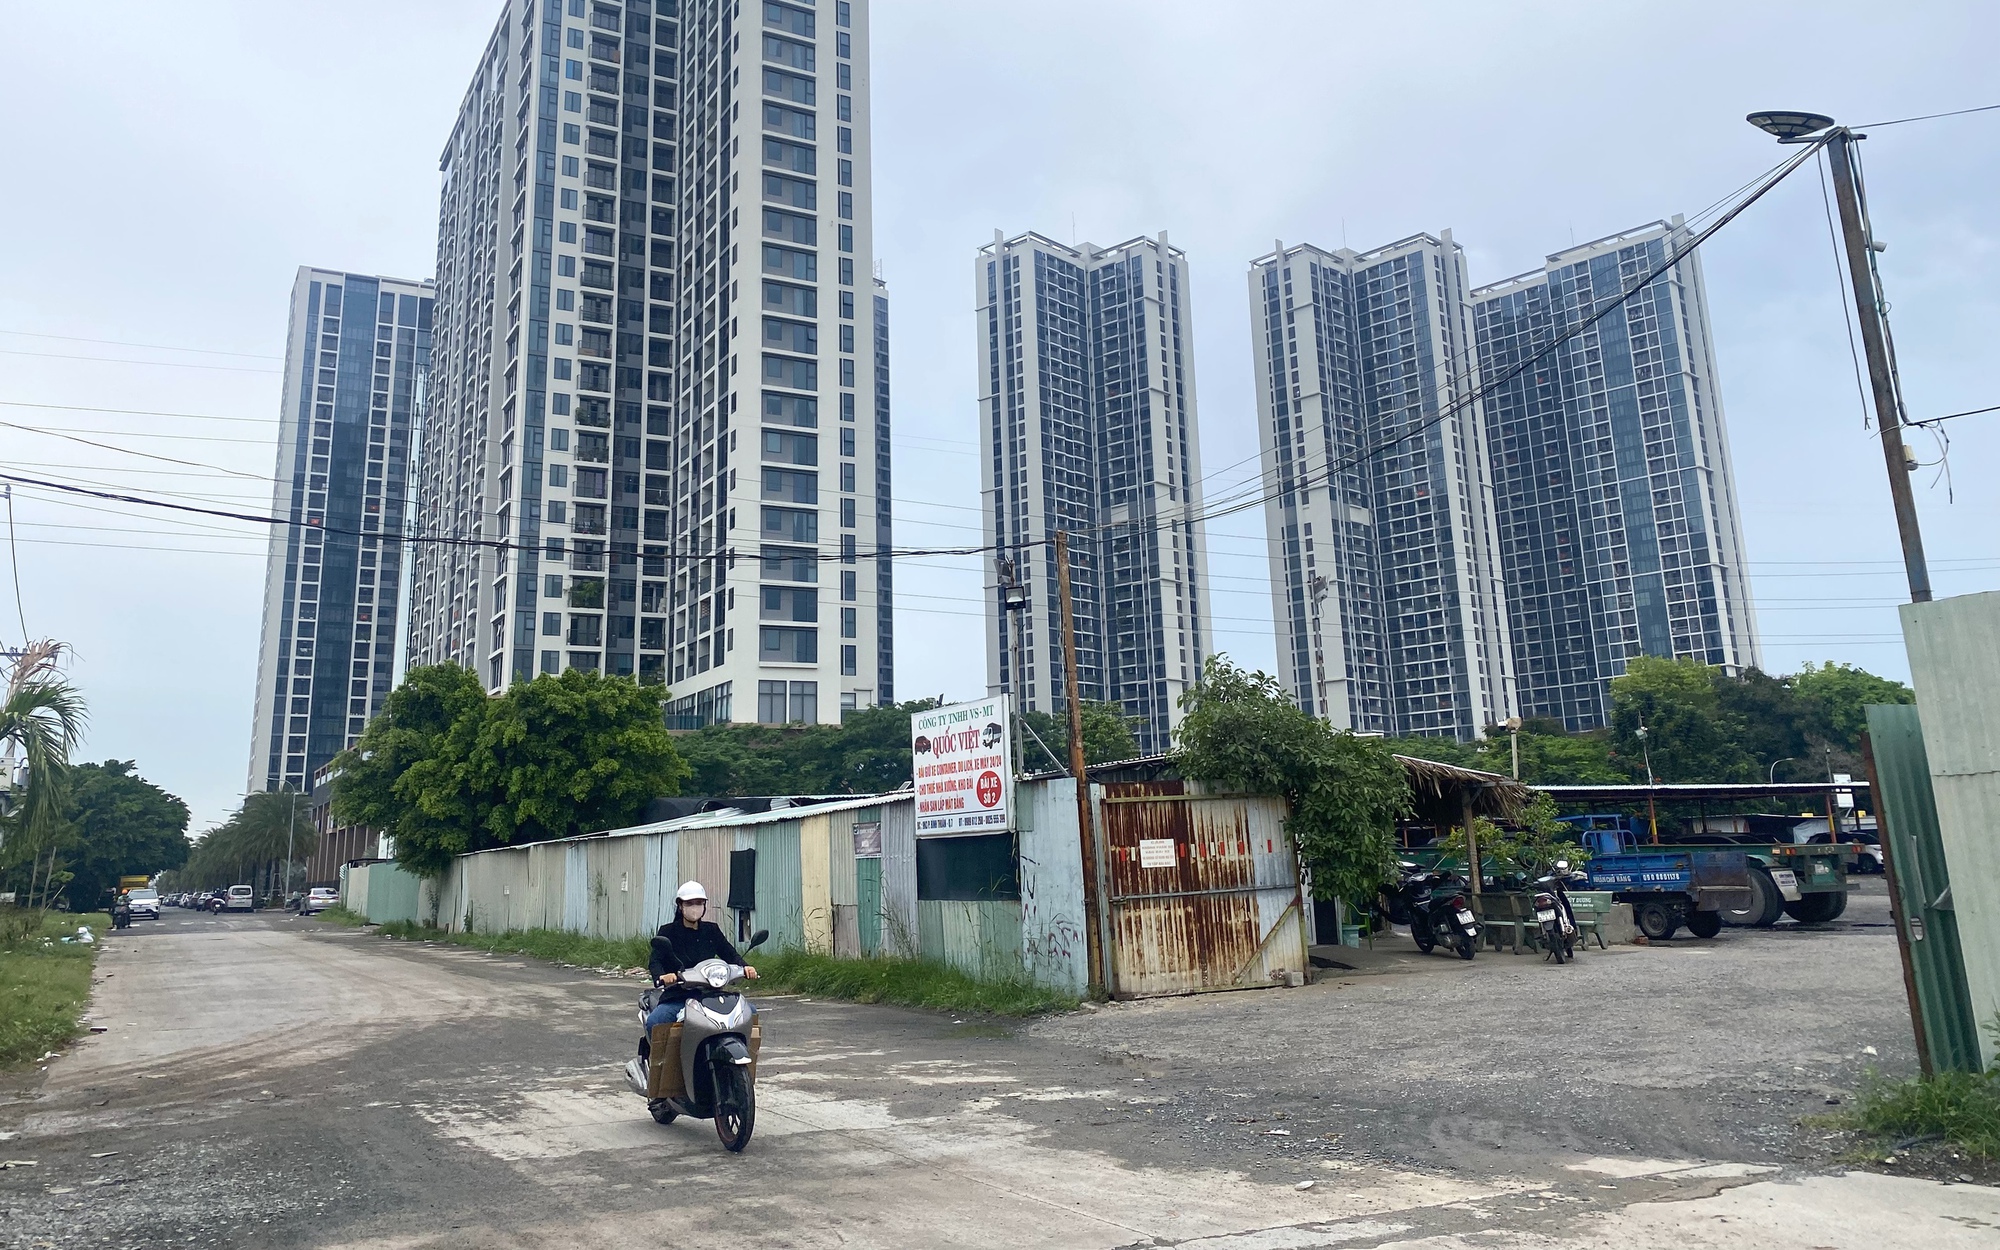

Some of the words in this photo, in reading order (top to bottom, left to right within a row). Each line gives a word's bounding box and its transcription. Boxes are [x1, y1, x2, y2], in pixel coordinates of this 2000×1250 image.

[918, 716, 937, 730] CÔNG
[939, 713, 947, 726] TY
[948, 710, 968, 724] TNHH
[932, 725, 957, 759] QUỐC
[957, 725, 981, 753] VIỆT
[990, 776, 998, 788] XE
[983, 789, 991, 804] SỐ
[991, 792, 996, 803] 2
